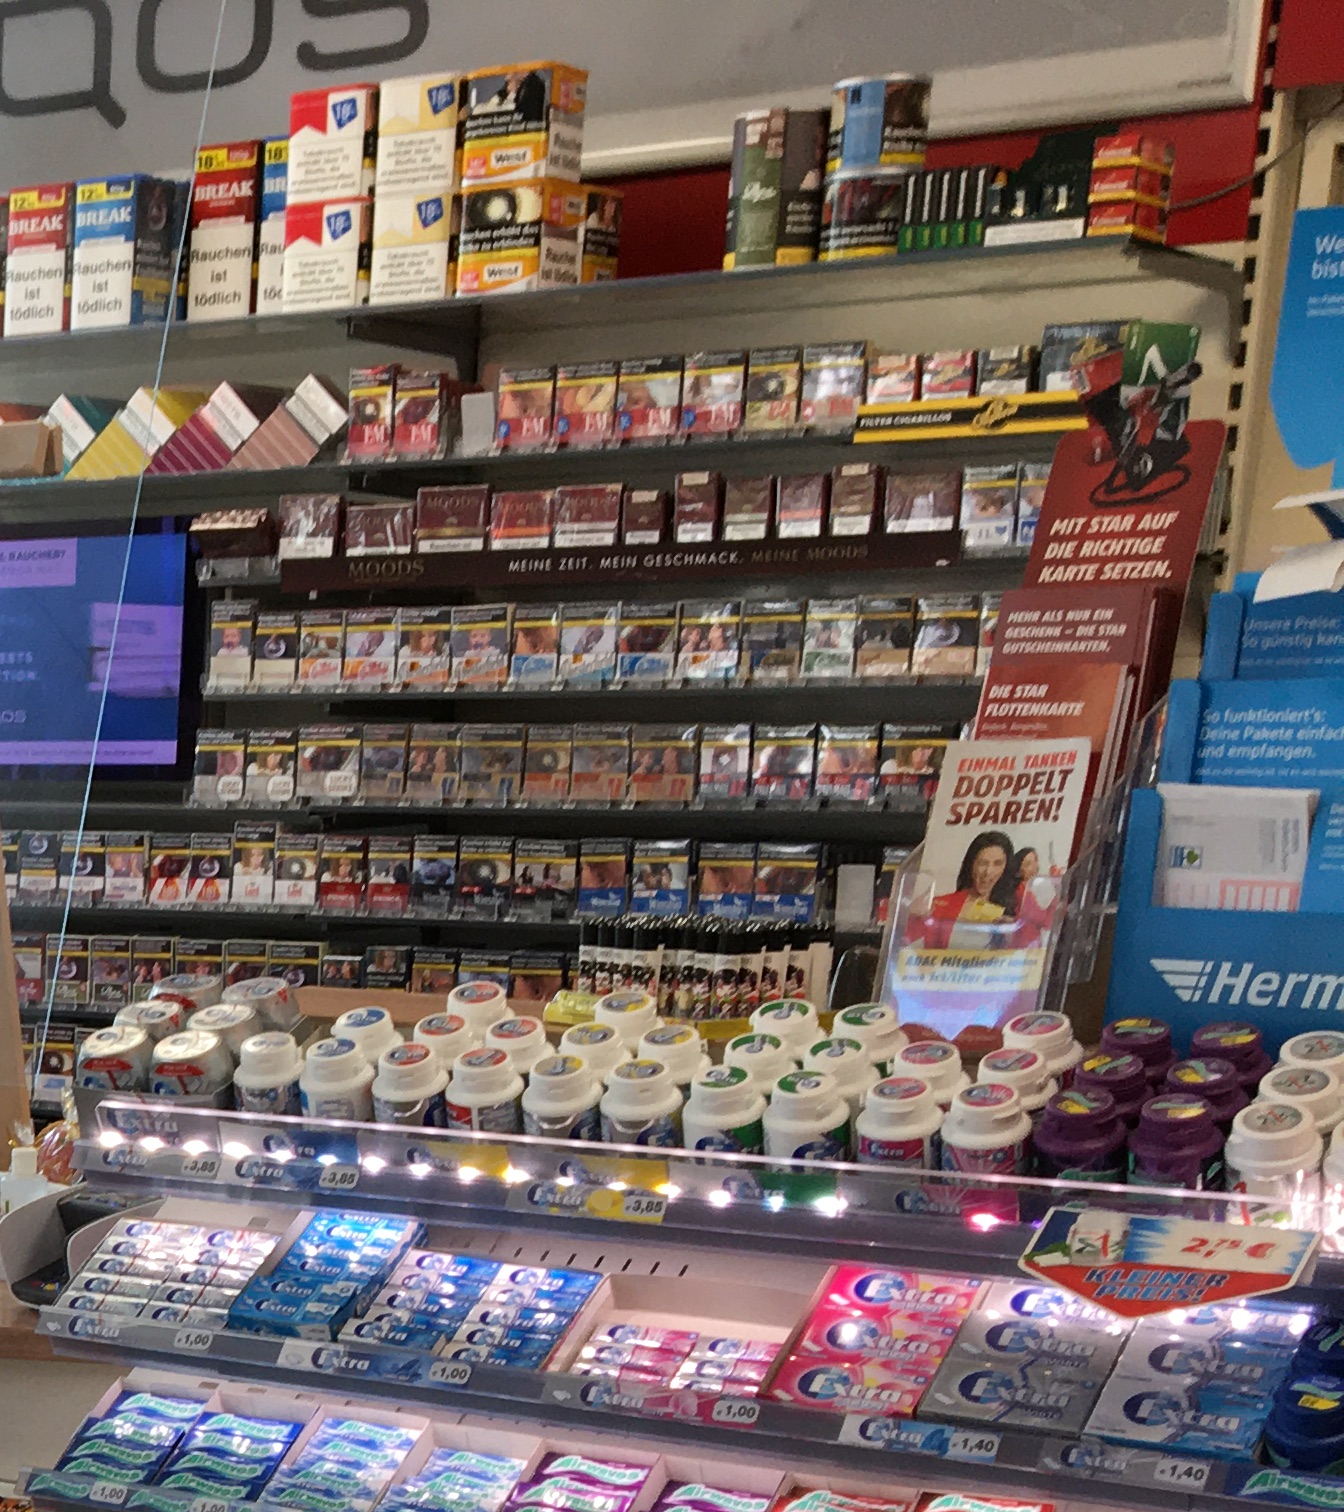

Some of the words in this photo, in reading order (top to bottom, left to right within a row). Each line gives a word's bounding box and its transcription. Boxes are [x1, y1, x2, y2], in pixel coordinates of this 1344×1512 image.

[195, 179, 253, 202] BREAK
[9, 214, 63, 236] BREAK
[77, 205, 132, 227] BREAK
[1049, 518, 1084, 536] MIT
[1087, 515, 1132, 534] STAR
[1137, 510, 1180, 530] AUF
[509, 557, 552, 573] MEINE
[558, 557, 593, 571] ZEIT.
[600, 555, 637, 570] MEIN
[643, 552, 744, 567] GESCHMACK.
[752, 548, 800, 563] MEINE
[806, 545, 871, 559] MOODS
[1044, 542, 1075, 560] DIE
[1078, 536, 1166, 558] RICHTIGE
[349, 558, 425, 577] MOODS
[1038, 563, 1097, 583] KARTE
[1100, 560, 1172, 580] SETZEN.
[1007, 612, 1040, 623] MEHR
[1042, 610, 1063, 621] ALS
[1065, 610, 1090, 621] NUR
[1092, 609, 1114, 620] EIN
[1004, 626, 1063, 639] GESCHENK
[1076, 625, 1096, 636] DIE
[1098, 624, 1127, 636] STAR
[989, 685, 1012, 698] DIE
[1013, 684, 1049, 698] STAR
[984, 702, 1085, 717] FLOTTENKARTE
[1200, 726, 1240, 740] Deine
[1243, 726, 1294, 740] Pakete
[957, 756, 1016, 774] EINMAL
[1024, 751, 1078, 771] TANKEN
[952, 768, 1074, 799] DOPPELT
[945, 796, 1064, 826] SPAREN!
[1083, 1268, 1229, 1288] KLEINER
[857, 1274, 957, 1308] Extra
[1096, 1283, 1206, 1302] PREIS!
[313, 1347, 370, 1371] Extra
[965, 1371, 1069, 1411] Extra
[116, 1391, 200, 1418] Airwaves
[1132, 1391, 1240, 1432] Extra
[548, 1454, 650, 1485] Airwaves
